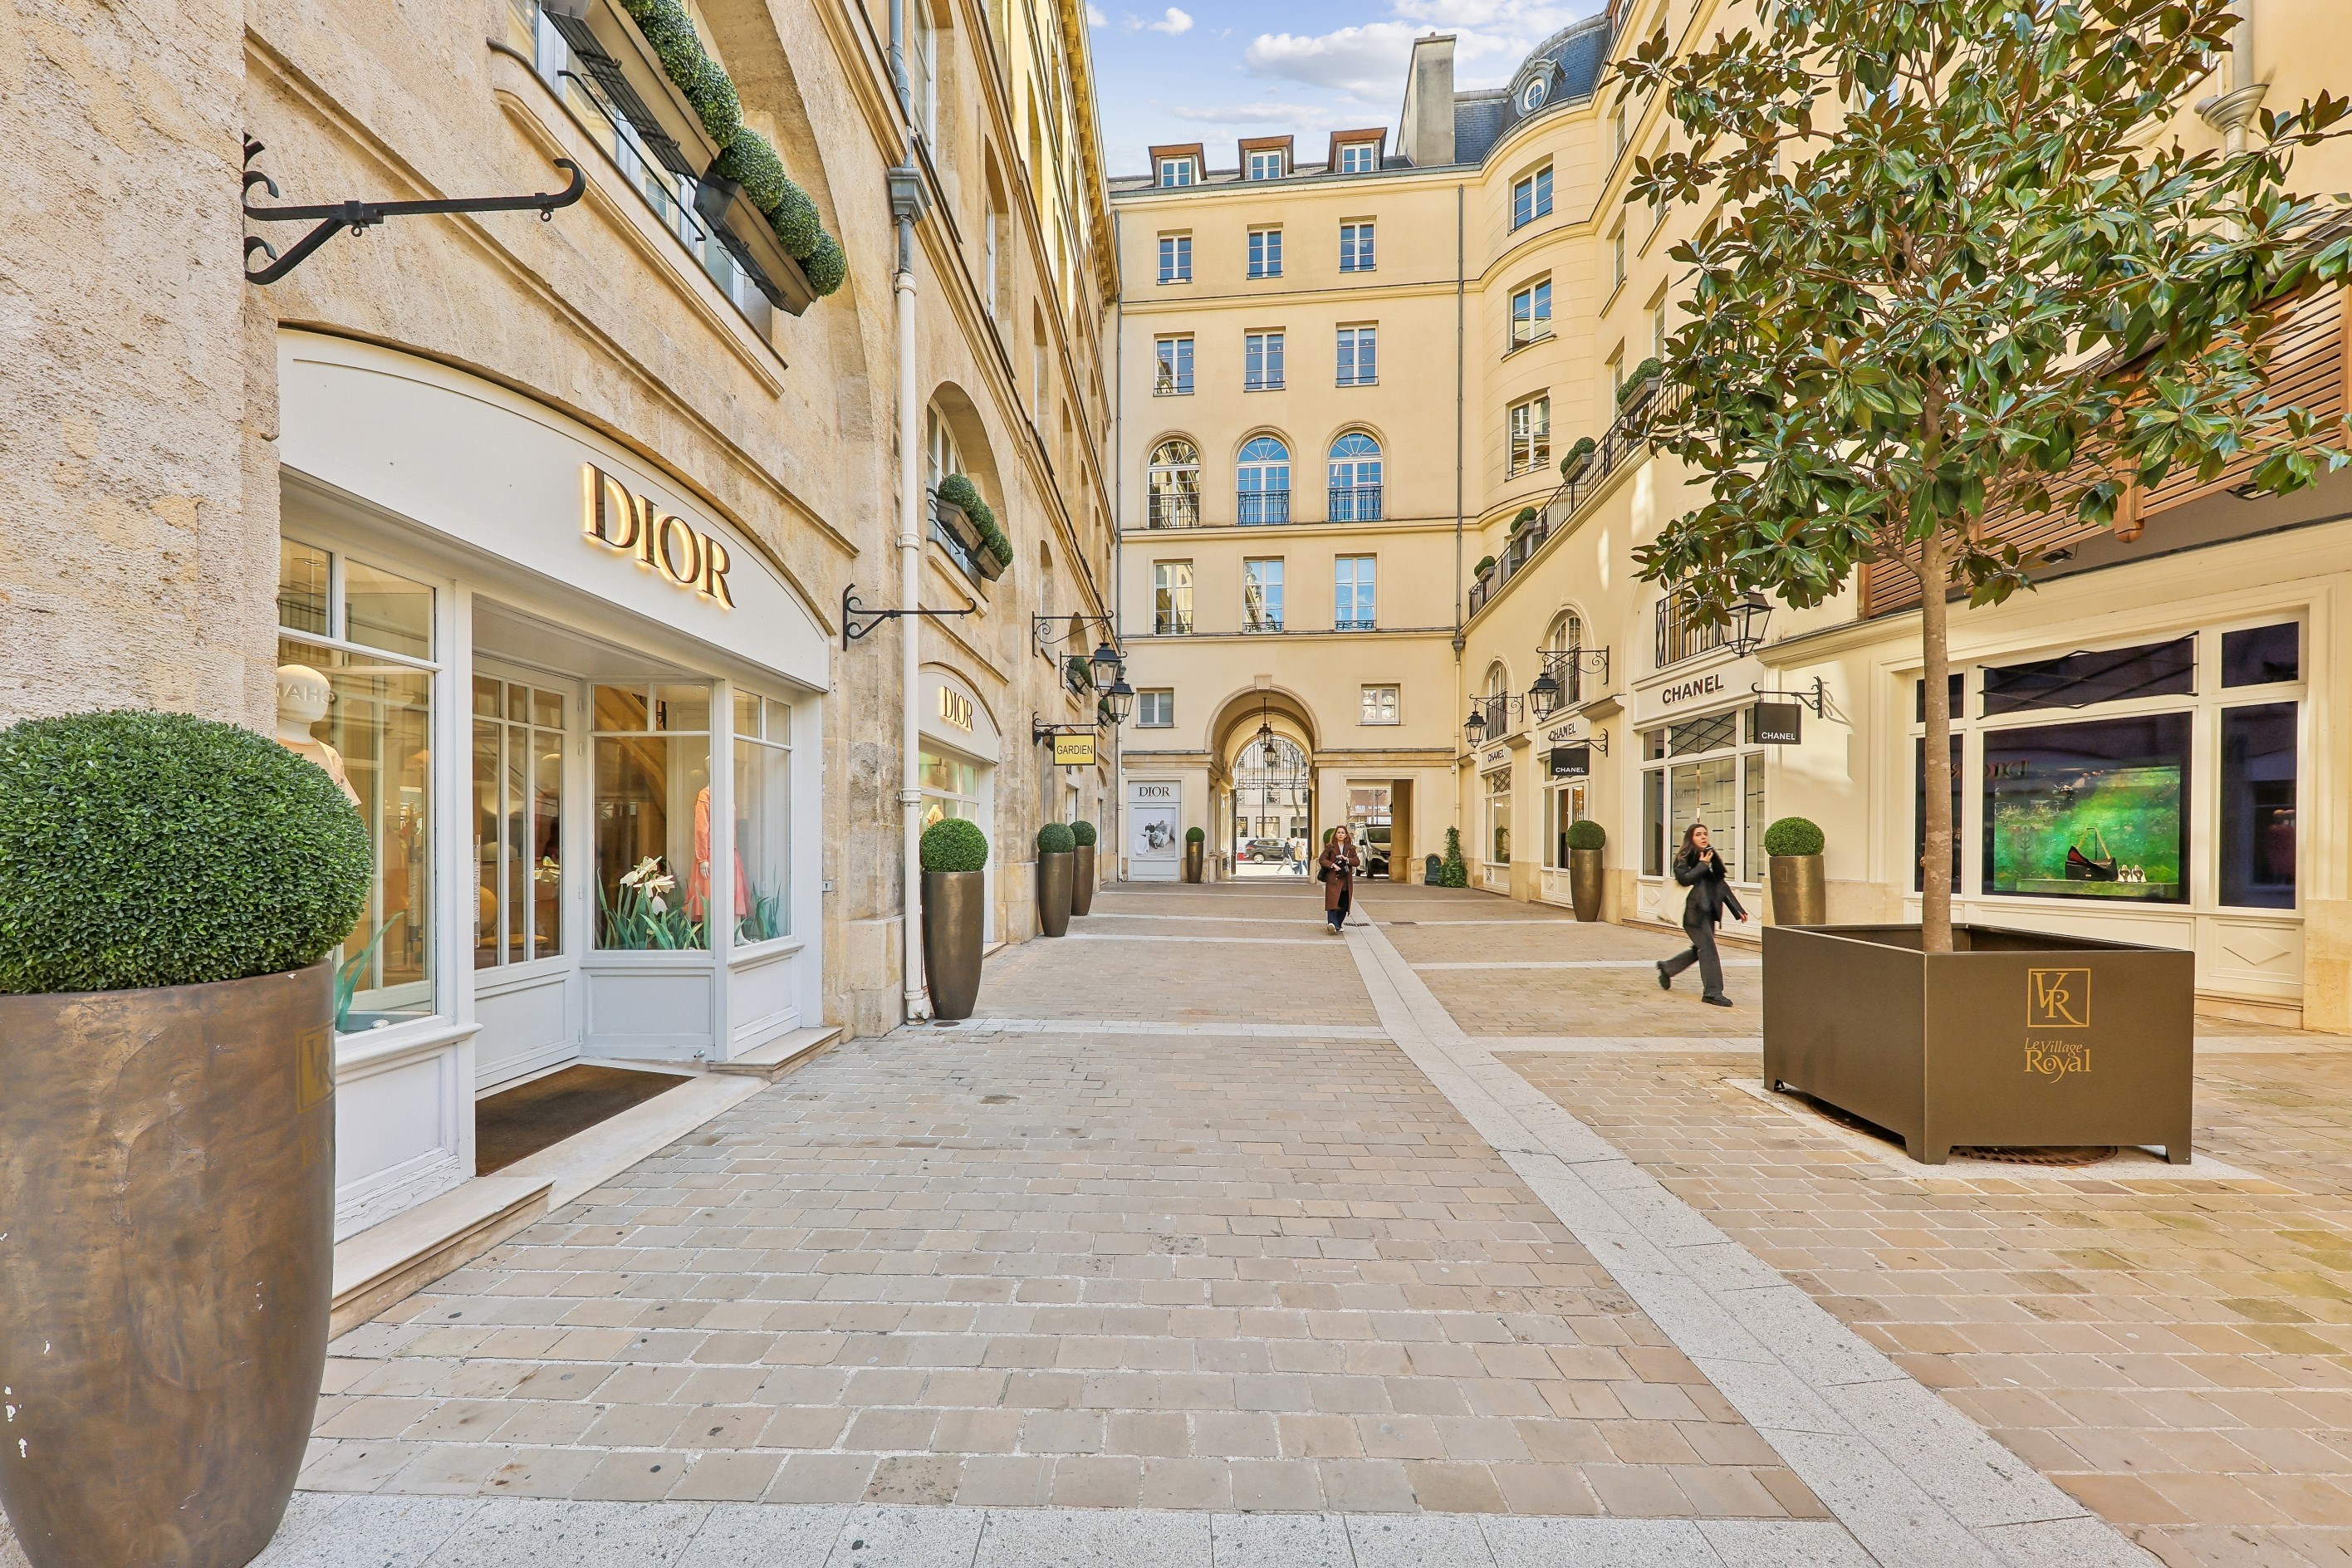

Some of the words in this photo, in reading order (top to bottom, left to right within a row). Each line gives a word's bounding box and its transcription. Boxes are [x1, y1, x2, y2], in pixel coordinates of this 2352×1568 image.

[584, 462, 737, 610] DIOR
[1662, 674, 1724, 705] CHANEL
[942, 685, 973, 732] DIOR
[1550, 723, 1577, 741] CHANEL
[1761, 731, 1796, 741] CHANEL
[1056, 744, 1093, 755] GARDIEN
[1487, 748, 1505, 762] CHANEL
[1139, 786, 1171, 797] DIOR
[2024, 1037, 2040, 1051] Le
[2041, 1039, 2083, 1058] Village
[2023, 1048, 2092, 1084] Royal
